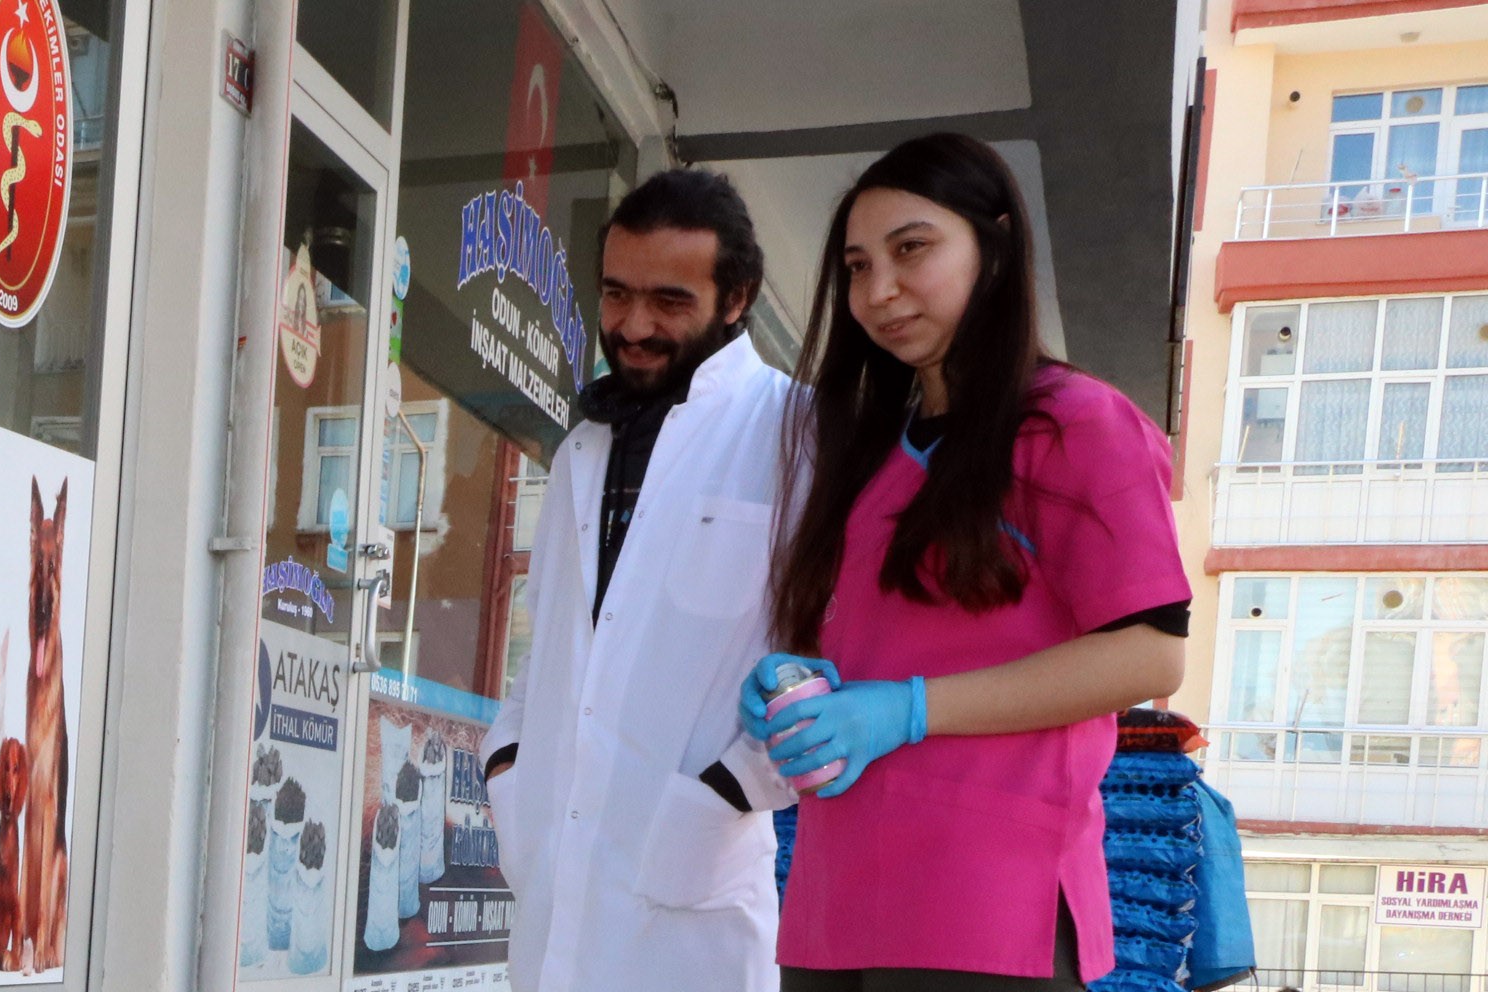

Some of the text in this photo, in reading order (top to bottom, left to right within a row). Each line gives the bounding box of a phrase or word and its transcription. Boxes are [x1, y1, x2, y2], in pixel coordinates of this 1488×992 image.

[54, 113, 66, 188] ODASI
[457, 180, 588, 395] HAŞİMOĞLU
[492, 287, 521, 340] ODUN
[526, 320, 559, 377] KÖMÜR
[470, 308, 570, 431] İNŞAAT MALZEMELERİ
[273, 649, 341, 713] ATAKAŞ
[273, 708, 335, 745] İTHAL KÖMÜR
[427, 901, 449, 934] ODUN
[453, 894, 479, 934] KÖMÜR
[482, 894, 505, 935] İNŞAAT
[1381, 897, 1479, 910] SOSYAL YARDIMLAŞMA
[1385, 909, 1473, 922] DAYANIŞMA DERNEĞİ
